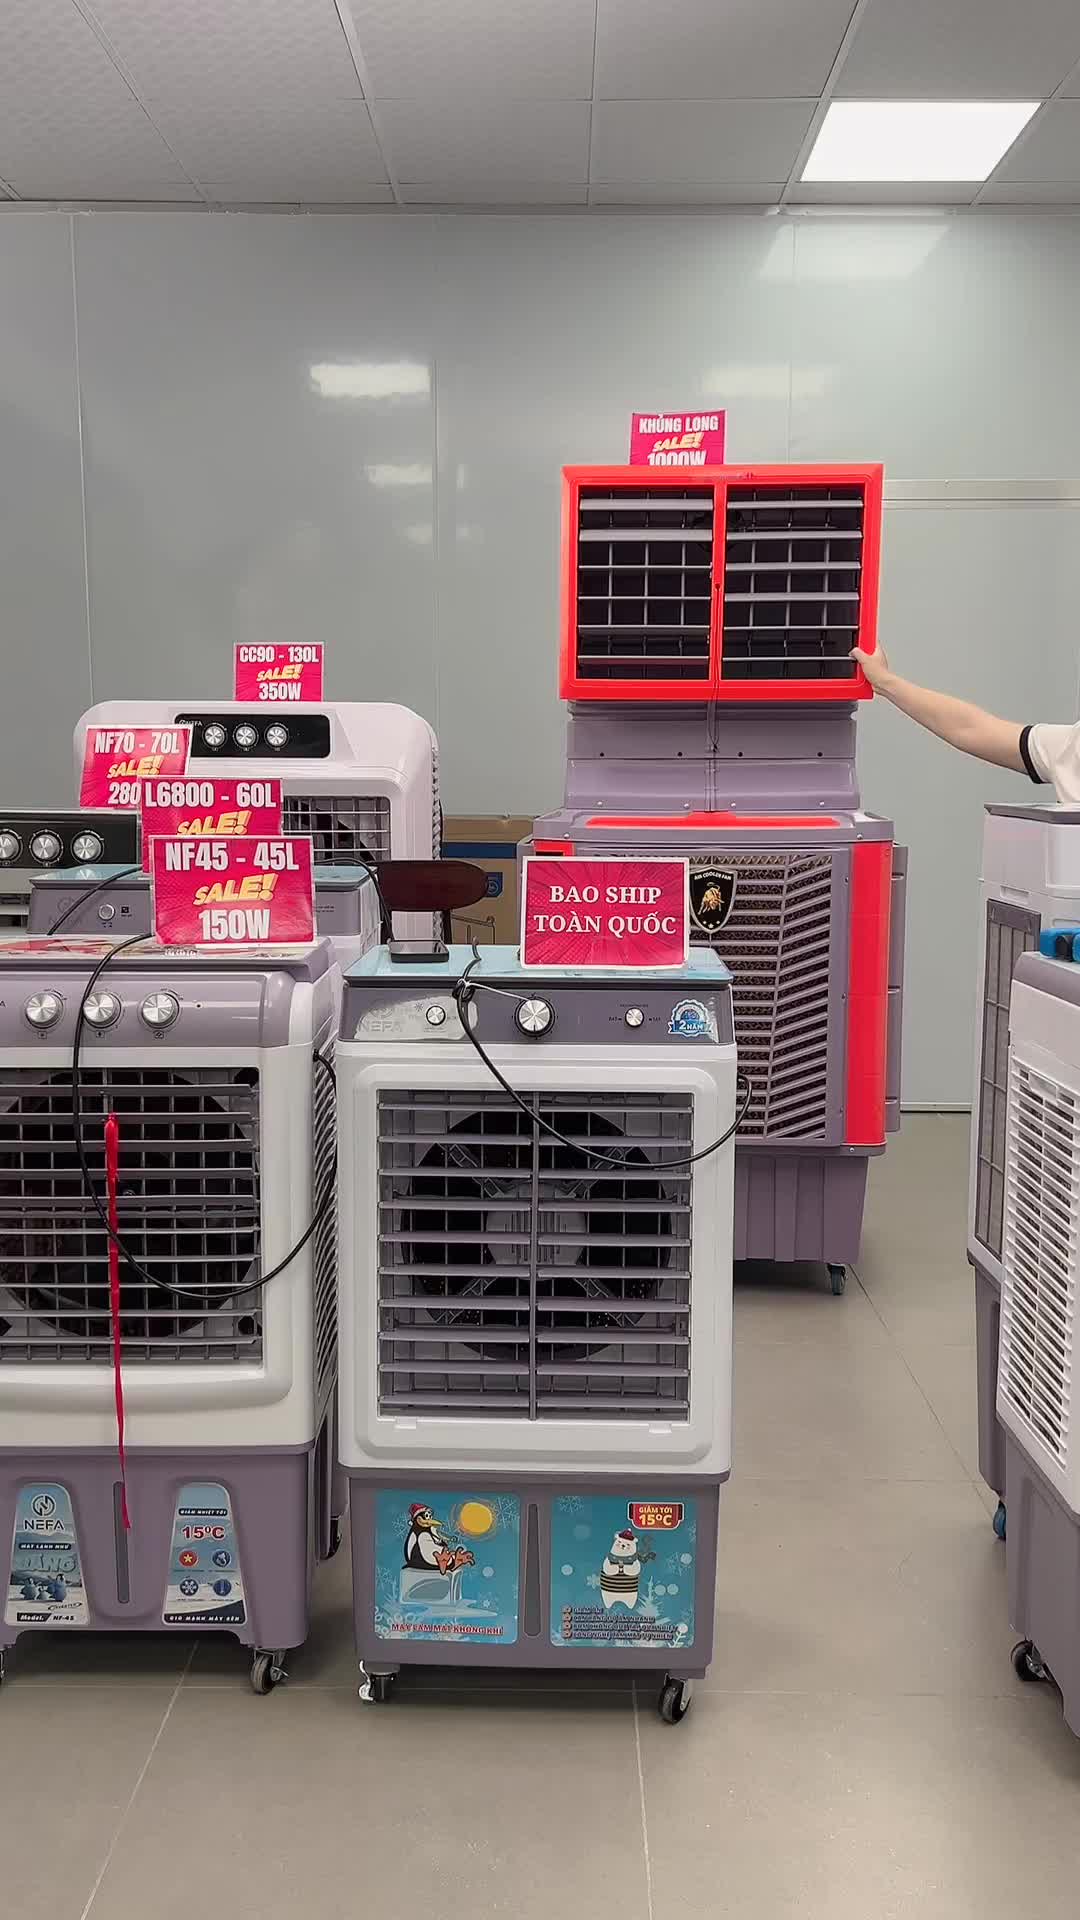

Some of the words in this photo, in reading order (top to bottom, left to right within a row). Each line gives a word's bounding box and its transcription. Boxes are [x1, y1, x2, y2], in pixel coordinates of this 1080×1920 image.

[639, 414, 682, 434] KHỦNG
[685, 415, 719, 432] LONG
[652, 432, 704, 452] SALE!
[647, 451, 706, 466] 1000W
[240, 646, 275, 663] CC90
[288, 646, 320, 663] 130L
[256, 663, 304, 682] SALE!
[258, 682, 302, 701] 350W
[94, 731, 136, 754] NF70
[151, 731, 180, 754] 70L
[106, 755, 165, 779] SALE!
[107, 781, 142, 805] 280
[145, 781, 215, 808] L6800
[236, 782, 277, 808] 60L
[176, 810, 252, 836] SALE!
[165, 842, 229, 871] NF45
[253, 842, 300, 871] 45L
[192, 873, 279, 906] SALE!
[549, 885, 599, 903] BAO
[605, 886, 662, 904] SHIP
[198, 909, 271, 940] 150W
[533, 910, 602, 933] TOÀN
[607, 911, 677, 938] QUỐC
[679, 1020, 688, 1030] 2
[24, 1519, 65, 1531] NEFA
